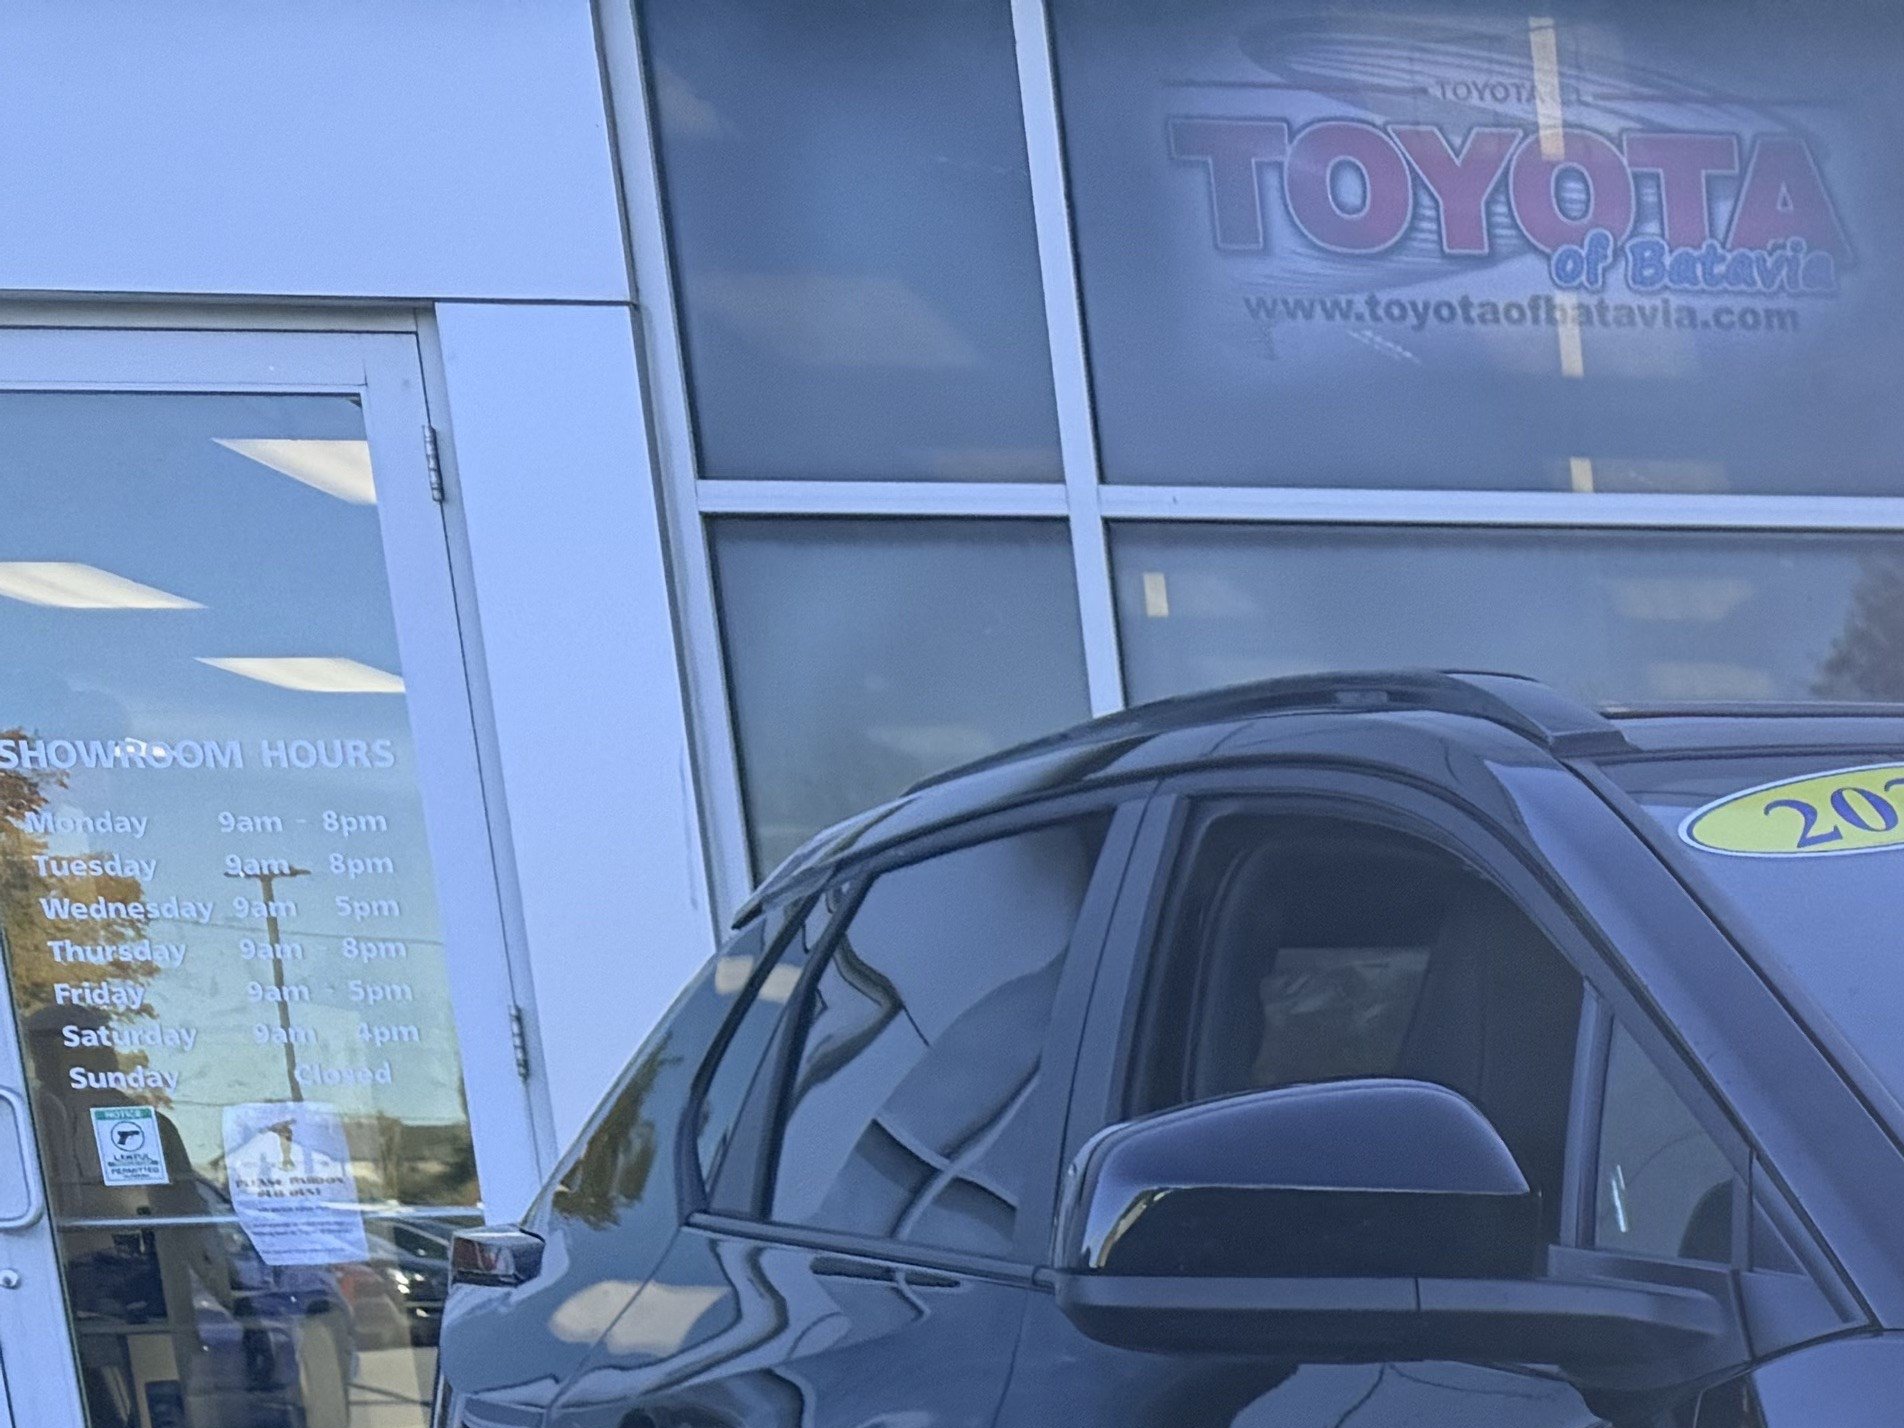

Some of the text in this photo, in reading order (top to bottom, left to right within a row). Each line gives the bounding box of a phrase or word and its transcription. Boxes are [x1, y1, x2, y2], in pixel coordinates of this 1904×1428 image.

[1169, 116, 1853, 264] TOYOTA
[1551, 230, 1838, 295] of Batavia
[1245, 295, 1799, 332] www.toyotaofbatavia.com
[0, 739, 394, 768] SHOWROOM HOURS
[25, 811, 148, 838] Monday
[218, 811, 283, 833] 9am
[322, 810, 387, 837] 8pm
[32, 852, 394, 881] Tuesday 9am 8pm
[39, 896, 400, 924] Wednesday 9am 5pm
[47, 938, 186, 969] Thursday
[240, 938, 304, 960] 9am
[342, 937, 406, 963] 8pm
[54, 981, 145, 1010] Friday
[248, 981, 310, 1002] 9am
[350, 979, 413, 1005] 5pm
[62, 1022, 421, 1051] Saturday 9am 4pm
[69, 1061, 392, 1095] Sunday Closed
